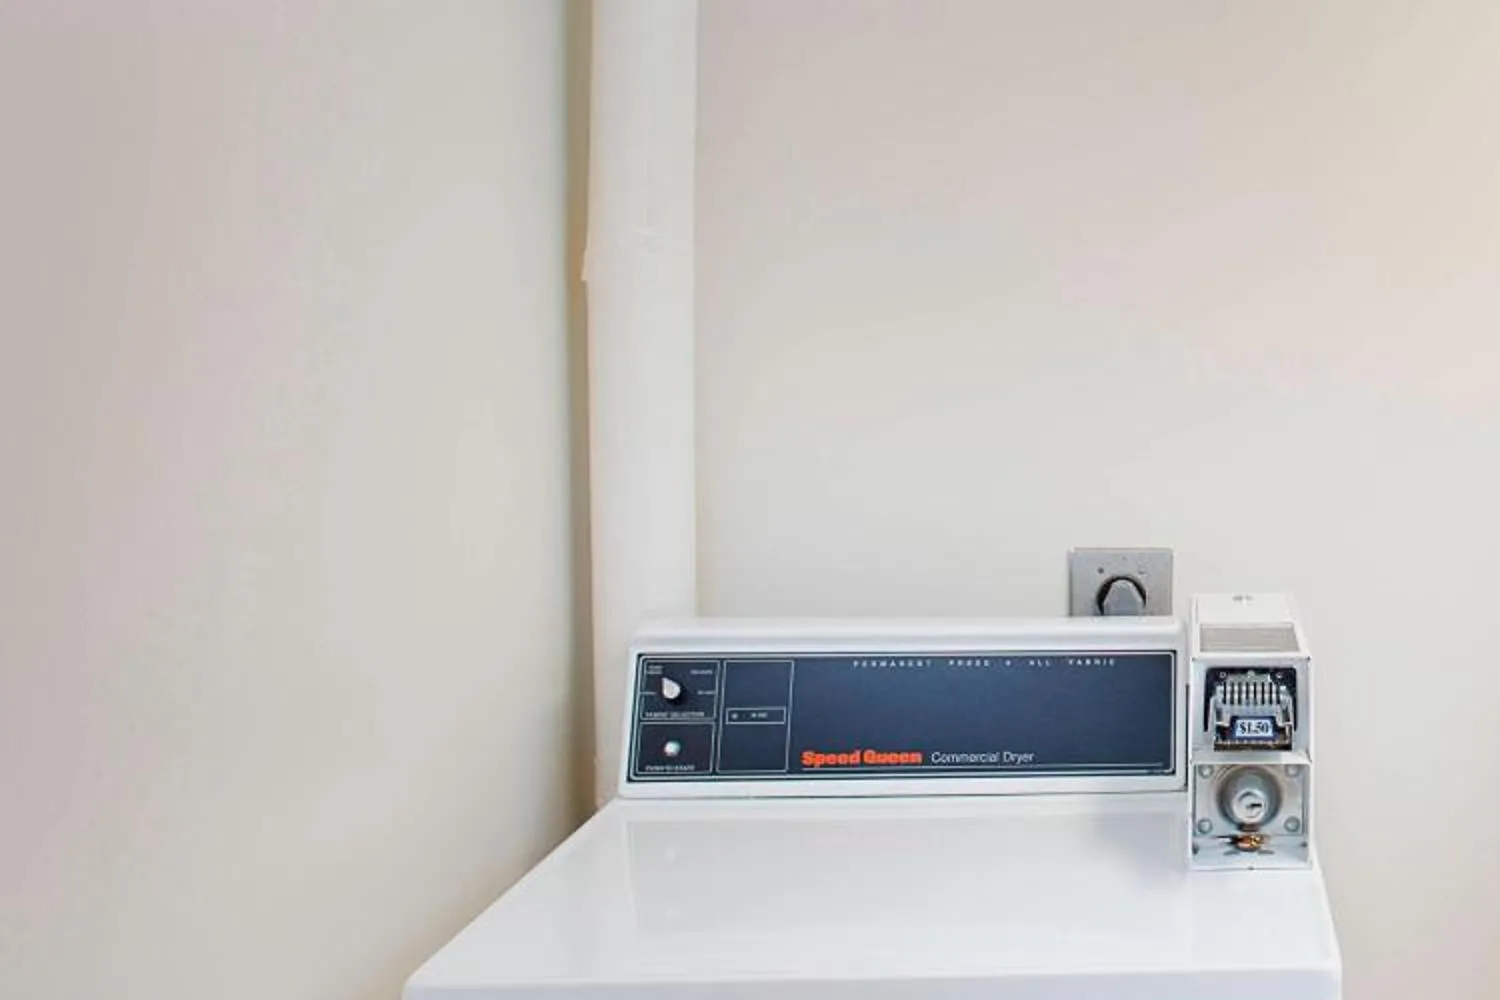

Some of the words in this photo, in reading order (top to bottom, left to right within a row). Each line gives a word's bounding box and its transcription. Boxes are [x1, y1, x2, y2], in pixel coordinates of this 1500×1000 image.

[802, 750, 861, 768] Speed
[863, 749, 923, 765] Queen
[931, 751, 1000, 764] Commercial
[1003, 751, 1034, 765] Dryer
